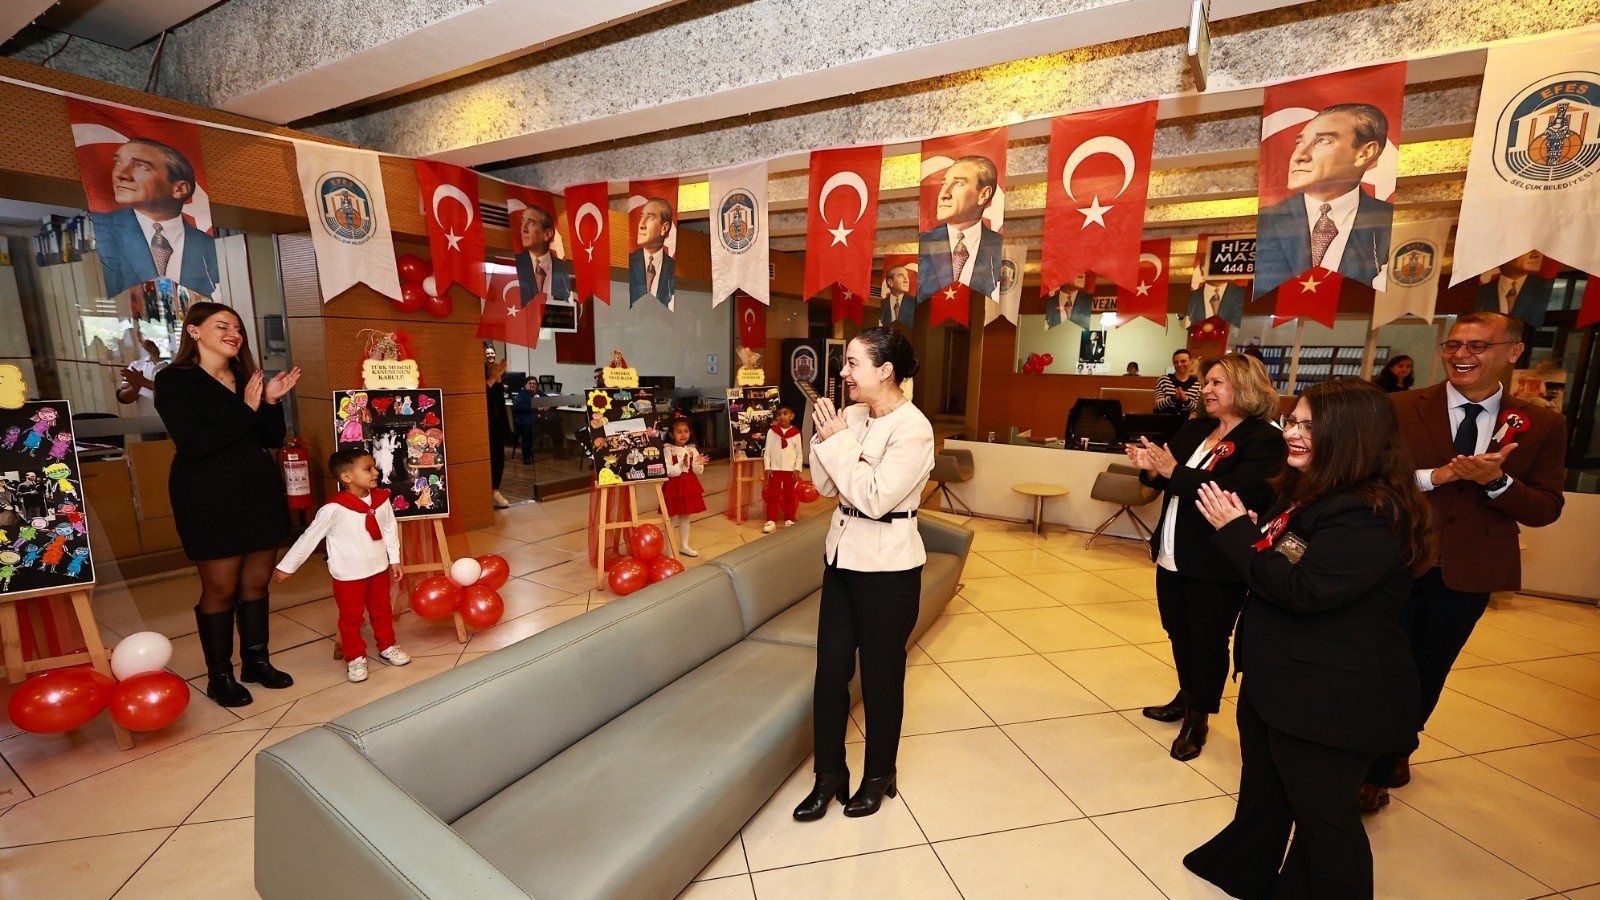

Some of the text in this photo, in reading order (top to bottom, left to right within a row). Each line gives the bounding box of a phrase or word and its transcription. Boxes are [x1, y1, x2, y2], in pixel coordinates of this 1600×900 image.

[1541, 83, 1589, 99] EFES
[1510, 171, 1594, 191] SELÇUK BELEDİYESİ
[1222, 264, 1243, 273] 444
